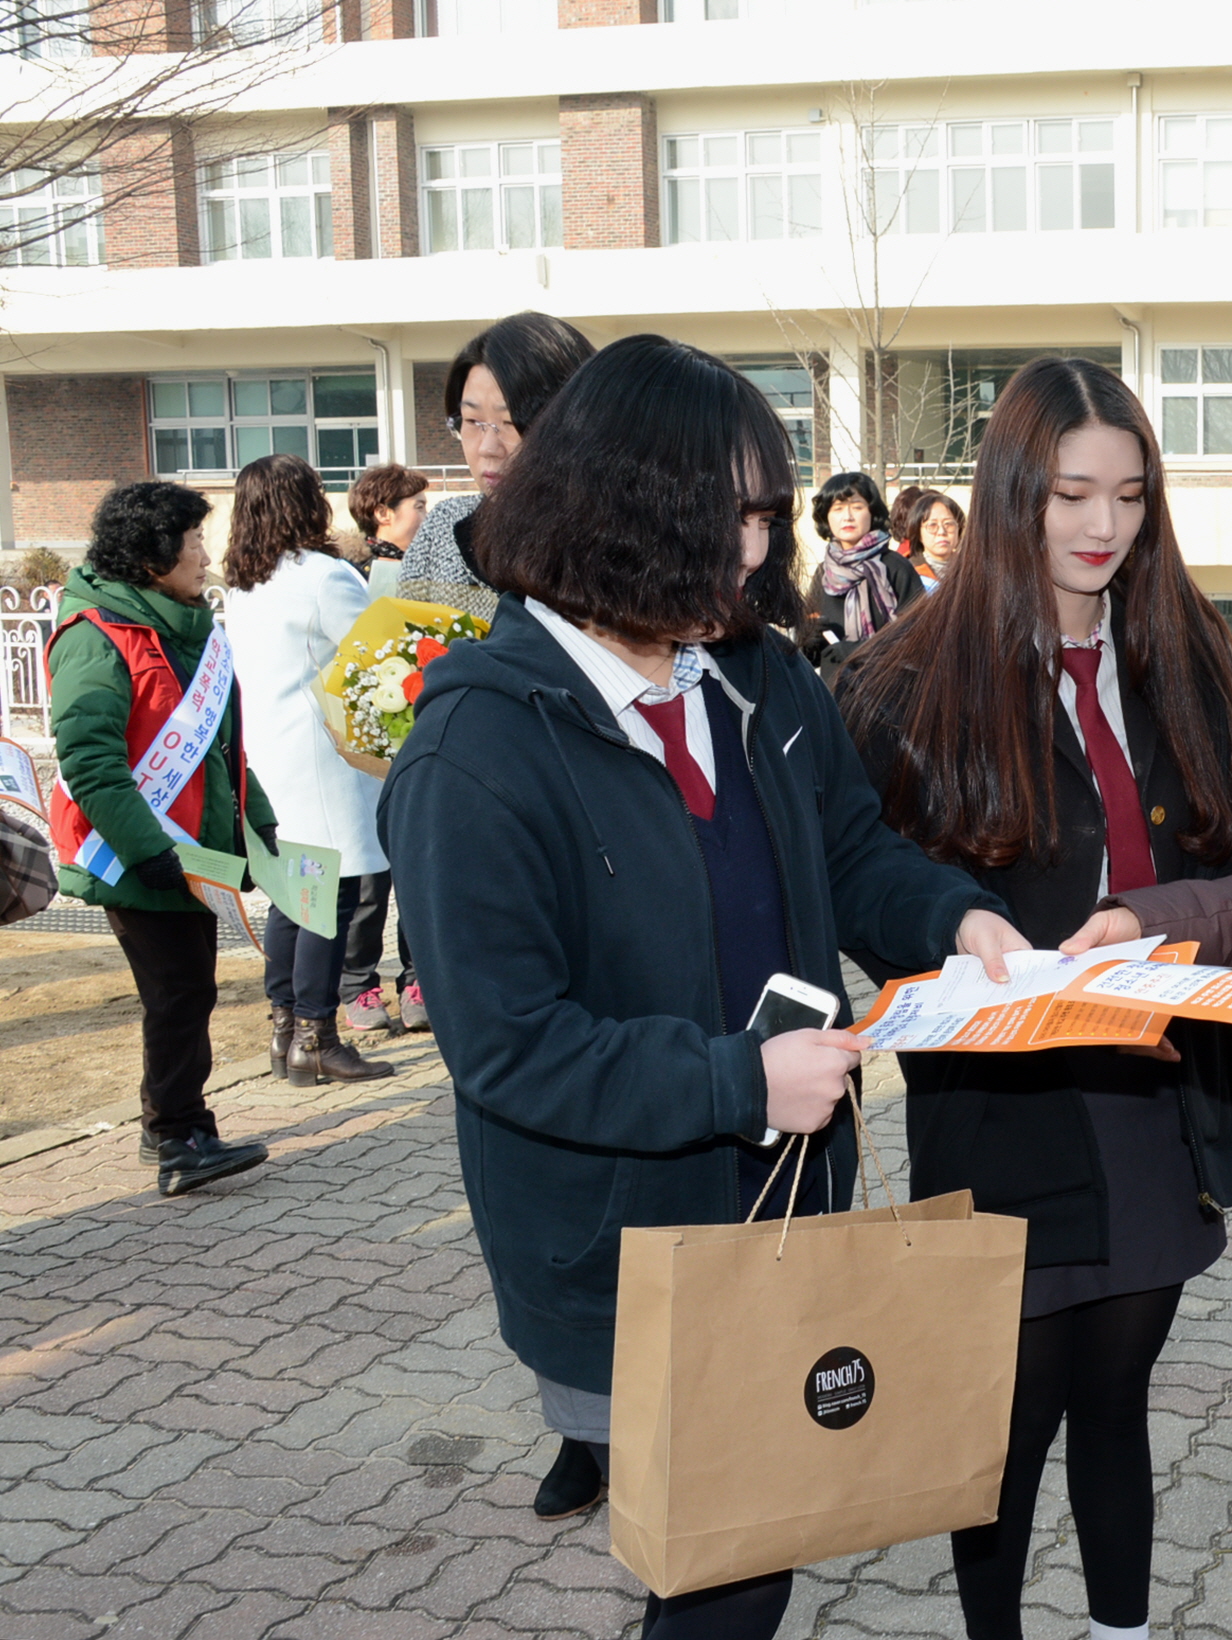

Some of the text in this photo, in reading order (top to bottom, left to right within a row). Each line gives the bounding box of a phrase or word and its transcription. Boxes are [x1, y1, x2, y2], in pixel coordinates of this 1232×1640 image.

[135, 638, 222, 791] 학교폭력 OUT
[180, 707, 217, 764] 행복한
[151, 768, 183, 808] 세상
